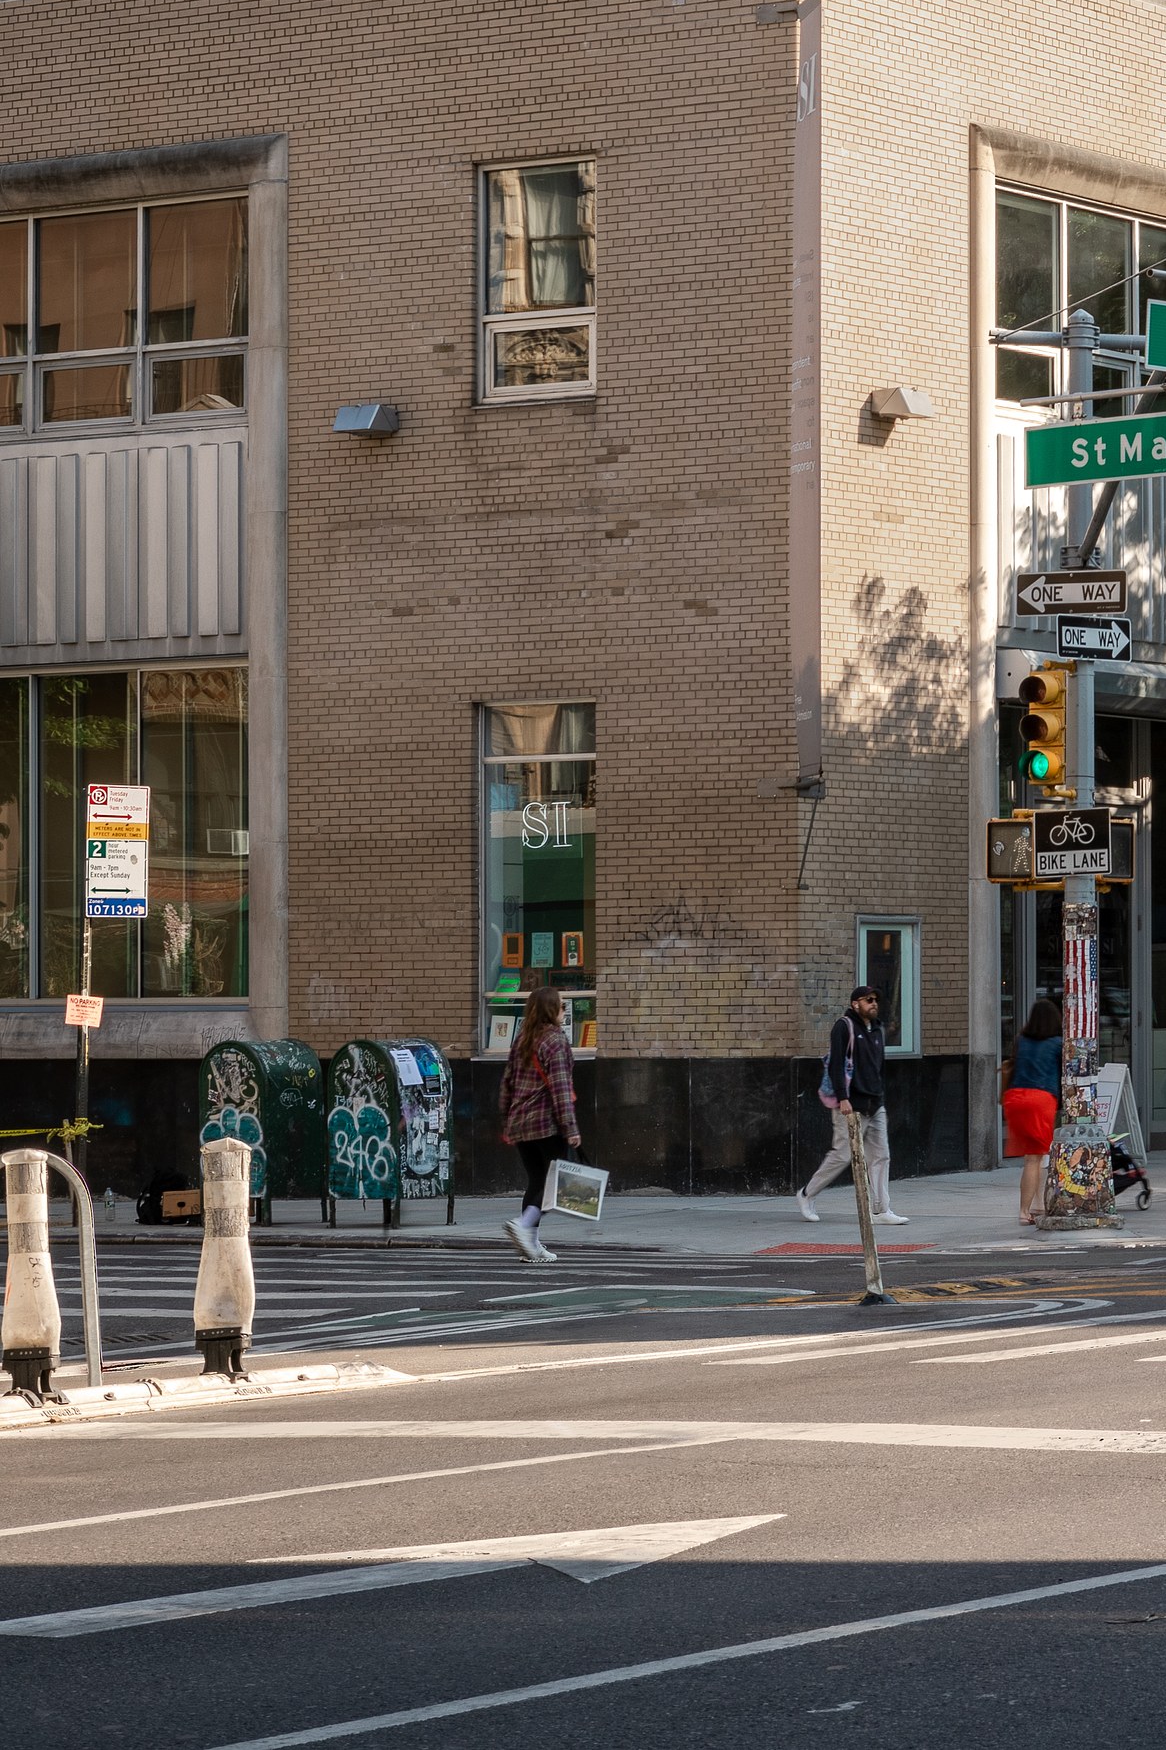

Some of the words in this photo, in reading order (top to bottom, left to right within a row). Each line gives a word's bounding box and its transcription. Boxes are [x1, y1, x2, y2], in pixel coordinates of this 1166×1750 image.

[1070, 436, 1107, 468] St
[1031, 586, 1063, 602] ONE
[1082, 584, 1117, 601] WAY
[1064, 628, 1087, 645] ONE
[1098, 630, 1121, 647] WAY
[522, 802, 573, 848] SI
[92, 842, 102, 857] 2
[1040, 854, 1067, 870] BIKE
[1073, 852, 1106, 868] LANE
[89, 905, 132, 915] 107130
